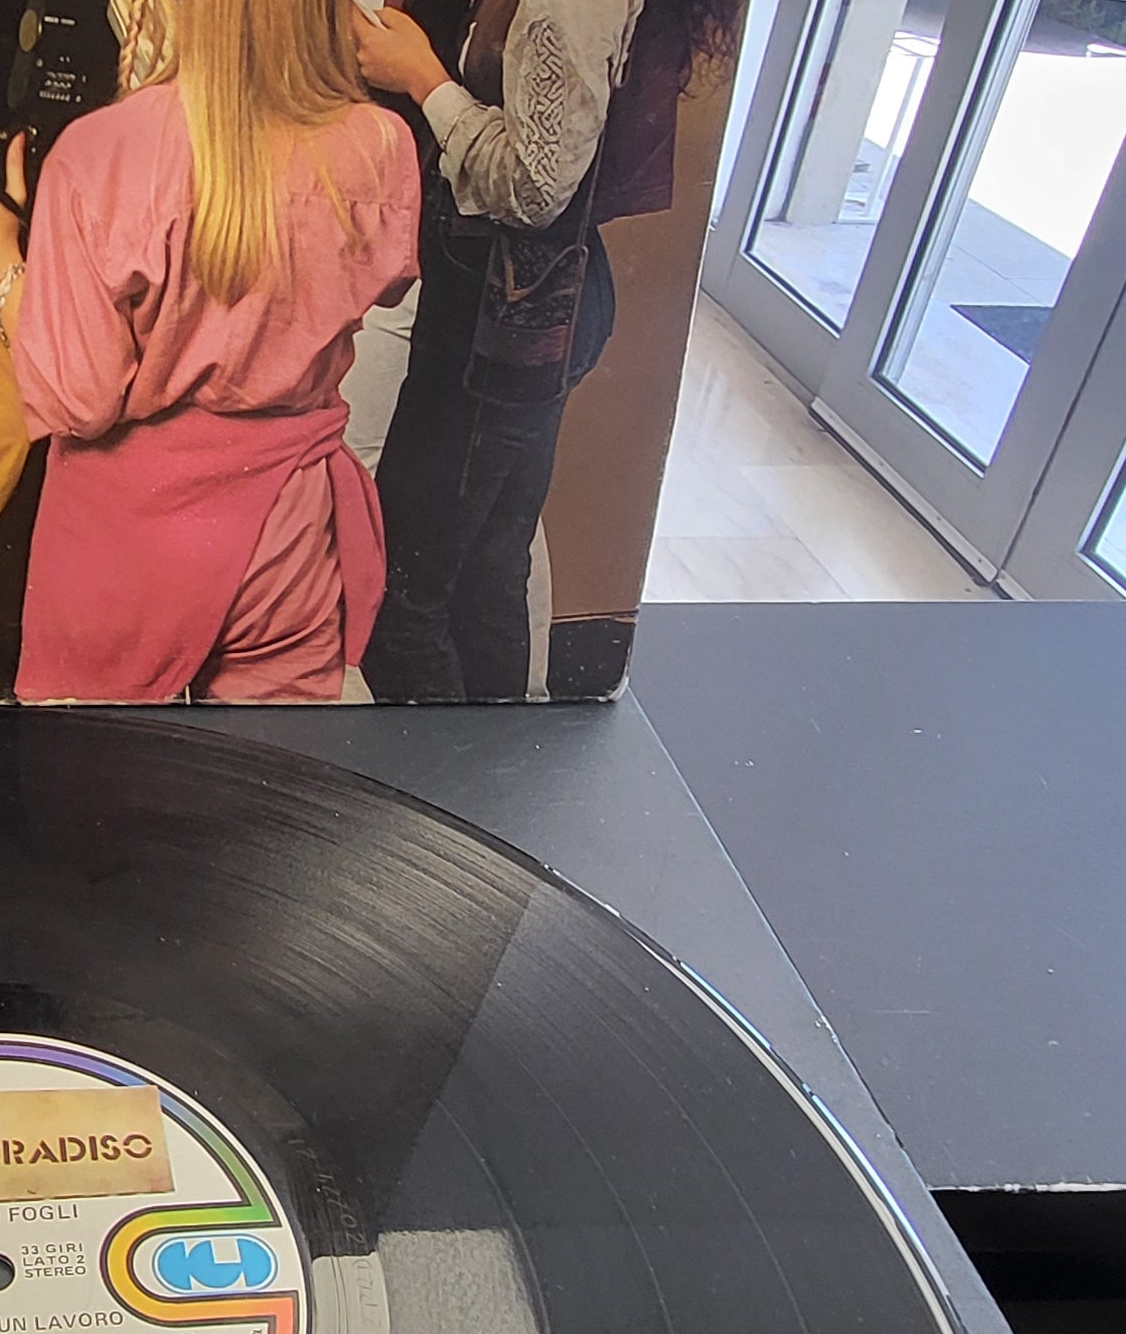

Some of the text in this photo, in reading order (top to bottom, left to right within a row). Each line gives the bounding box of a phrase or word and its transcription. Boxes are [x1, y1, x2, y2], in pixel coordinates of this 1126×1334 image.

[9, 1203, 79, 1223] FOGLI
[21, 1242, 83, 1255] 33 GIRI
[23, 1254, 85, 1267] LATO 2
[24, 1266, 86, 1278] STEREO
[35, 1311, 124, 1331] LAVORO
